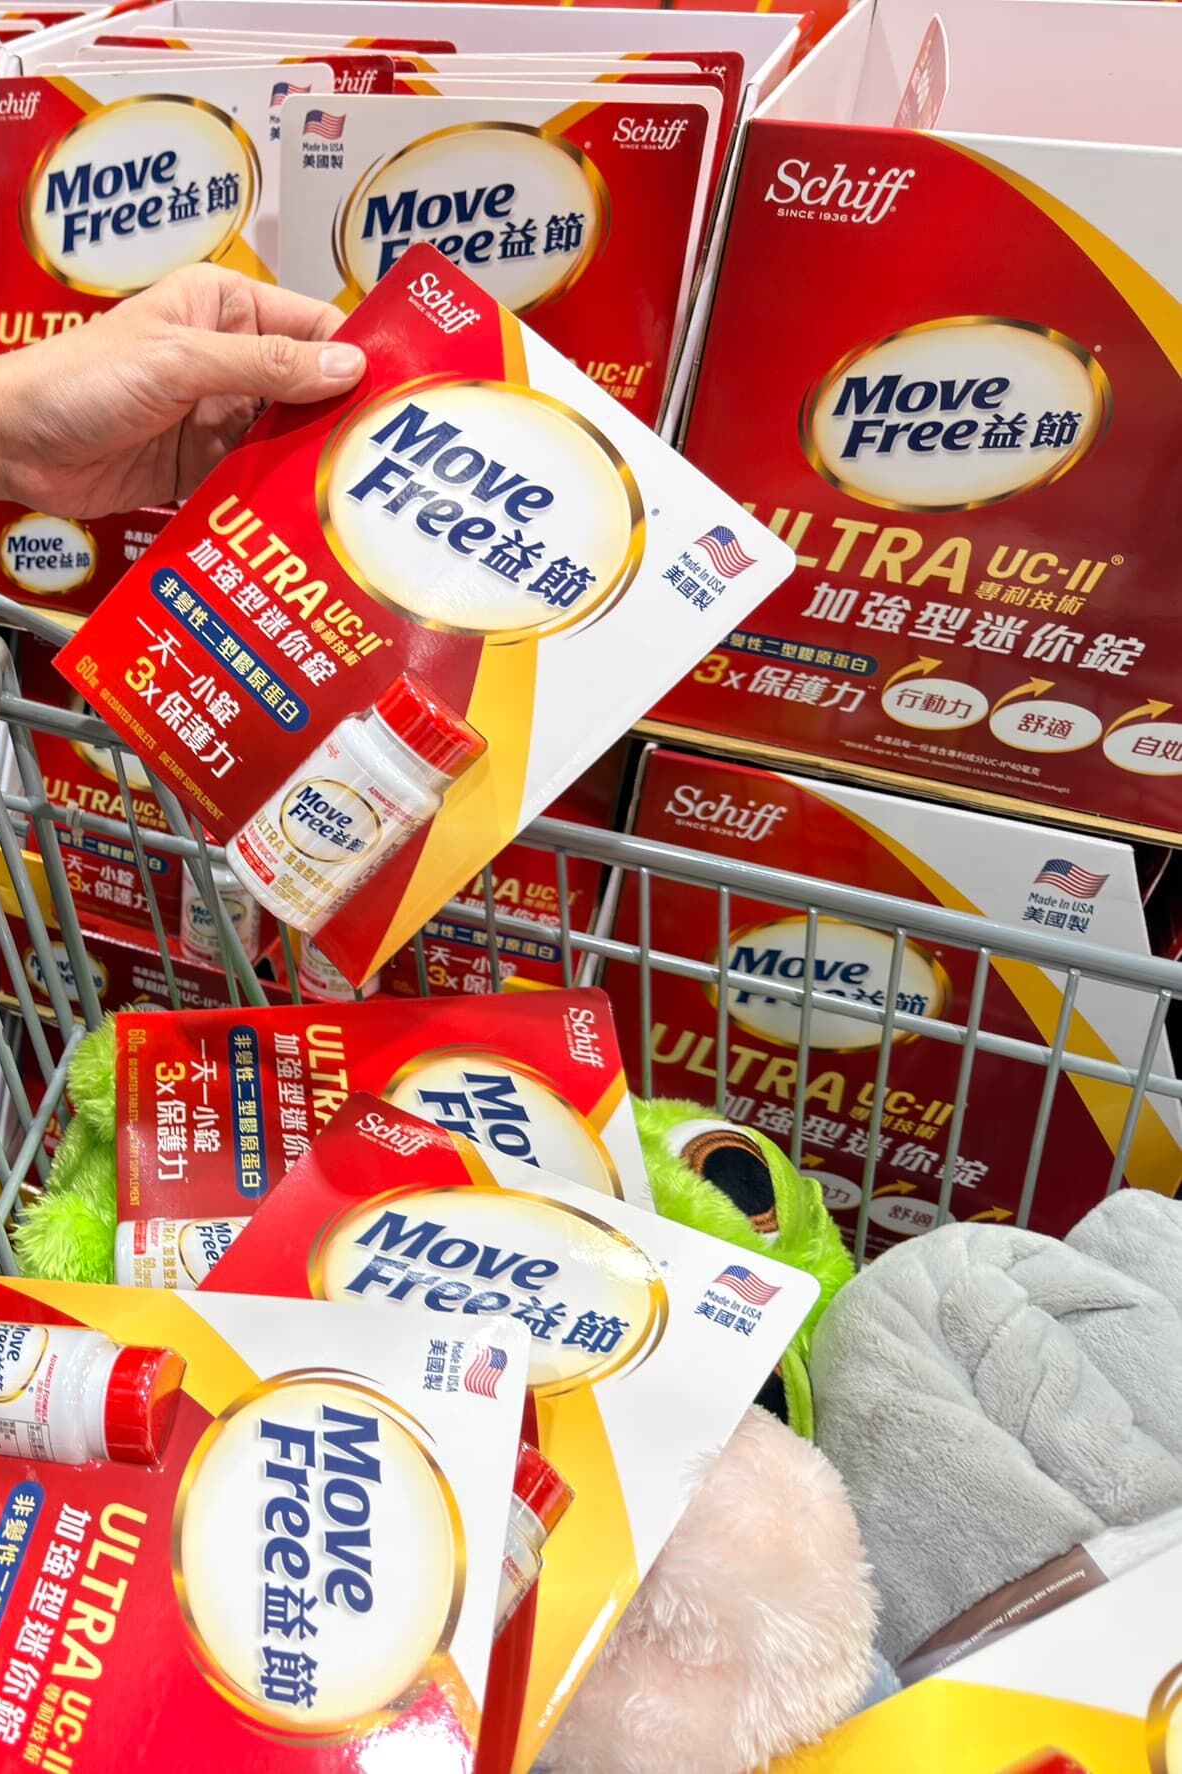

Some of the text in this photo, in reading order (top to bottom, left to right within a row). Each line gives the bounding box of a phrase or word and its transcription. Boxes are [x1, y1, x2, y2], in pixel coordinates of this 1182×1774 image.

[302, 142, 320, 152] Made
[330, 143, 344, 152] USA
[612, 117, 689, 150] Schiff
[45, 150, 177, 214] Move
[302, 154, 344, 169] 美國製
[62, 172, 240, 254] Free 益節
[361, 183, 516, 240] Move
[764, 158, 916, 225] Schiff
[776, 208, 848, 223] SINCE 1936
[376, 212, 586, 282] Fee 益節
[408, 272, 481, 334] Schiff
[831, 374, 1010, 419] Move
[840, 410, 1084, 460] Free 益節
[369, 403, 555, 525] Move
[7, 536, 63, 553] Move
[208, 494, 329, 620] ULTRA
[346, 456, 599, 611] Free 益節
[14, 551, 90, 572] Free 益節
[661, 564, 715, 612] 美國製
[678, 551, 726, 596] Made In USA
[186, 538, 338, 687] 加強型迷你錠
[973, 581, 1087, 617] 專利技術
[158, 577, 300, 724] 非變性二型膠原蛋白
[310, 619, 361, 668] 專利技術
[799, 582, 1148, 678] 加強型迷你錠
[136, 616, 241, 728] 一天一小錠
[693, 652, 867, 716] 3x 保護力
[124, 656, 238, 778] 3x 保護力
[895, 687, 974, 721] 行動力
[1017, 711, 1075, 742] 舒適
[109, 697, 132, 725] COATED
[128, 720, 156, 750] TABLETS
[158, 752, 188, 783] DIETARY
[181, 777, 224, 820] SUPPLEMENT
[42, 776, 127, 818] ULTRA
[296, 785, 354, 829] Move
[664, 785, 788, 842] Schiff
[255, 811, 285, 855] ULTRA
[288, 803, 367, 853] Free 益節
[1021, 906, 1091, 933] 美國製
[1028, 892, 1094, 915] Made In USA
[729, 946, 869, 985] Move
[567, 1006, 604, 1068] Schiff
[190, 1038, 221, 1153] 一天一小錠
[650, 1023, 847, 1115] ULTRA
[155, 1062, 188, 1181] 3x 保護力
[234, 1034, 261, 1188] 非變性二型膠原蛋白
[356, 1112, 431, 1157] Schiff
[355, 1210, 559, 1291] Move
[345, 1256, 630, 1356] Free 益節
[694, 1301, 757, 1336] 美國製
[704, 1289, 762, 1321] Made In USA
[423, 1339, 448, 1391] 美國製
[451, 1340, 465, 1364] Made
[446, 1374, 459, 1393] USA
[322, 1404, 381, 1613] Move
[259, 1418, 319, 1709] Free 益節
[1047, 1568, 1087, 1594] Accessories
[51, 1502, 148, 1681] ULTRA
[23, 1683, 61, 1766] 專利技術
